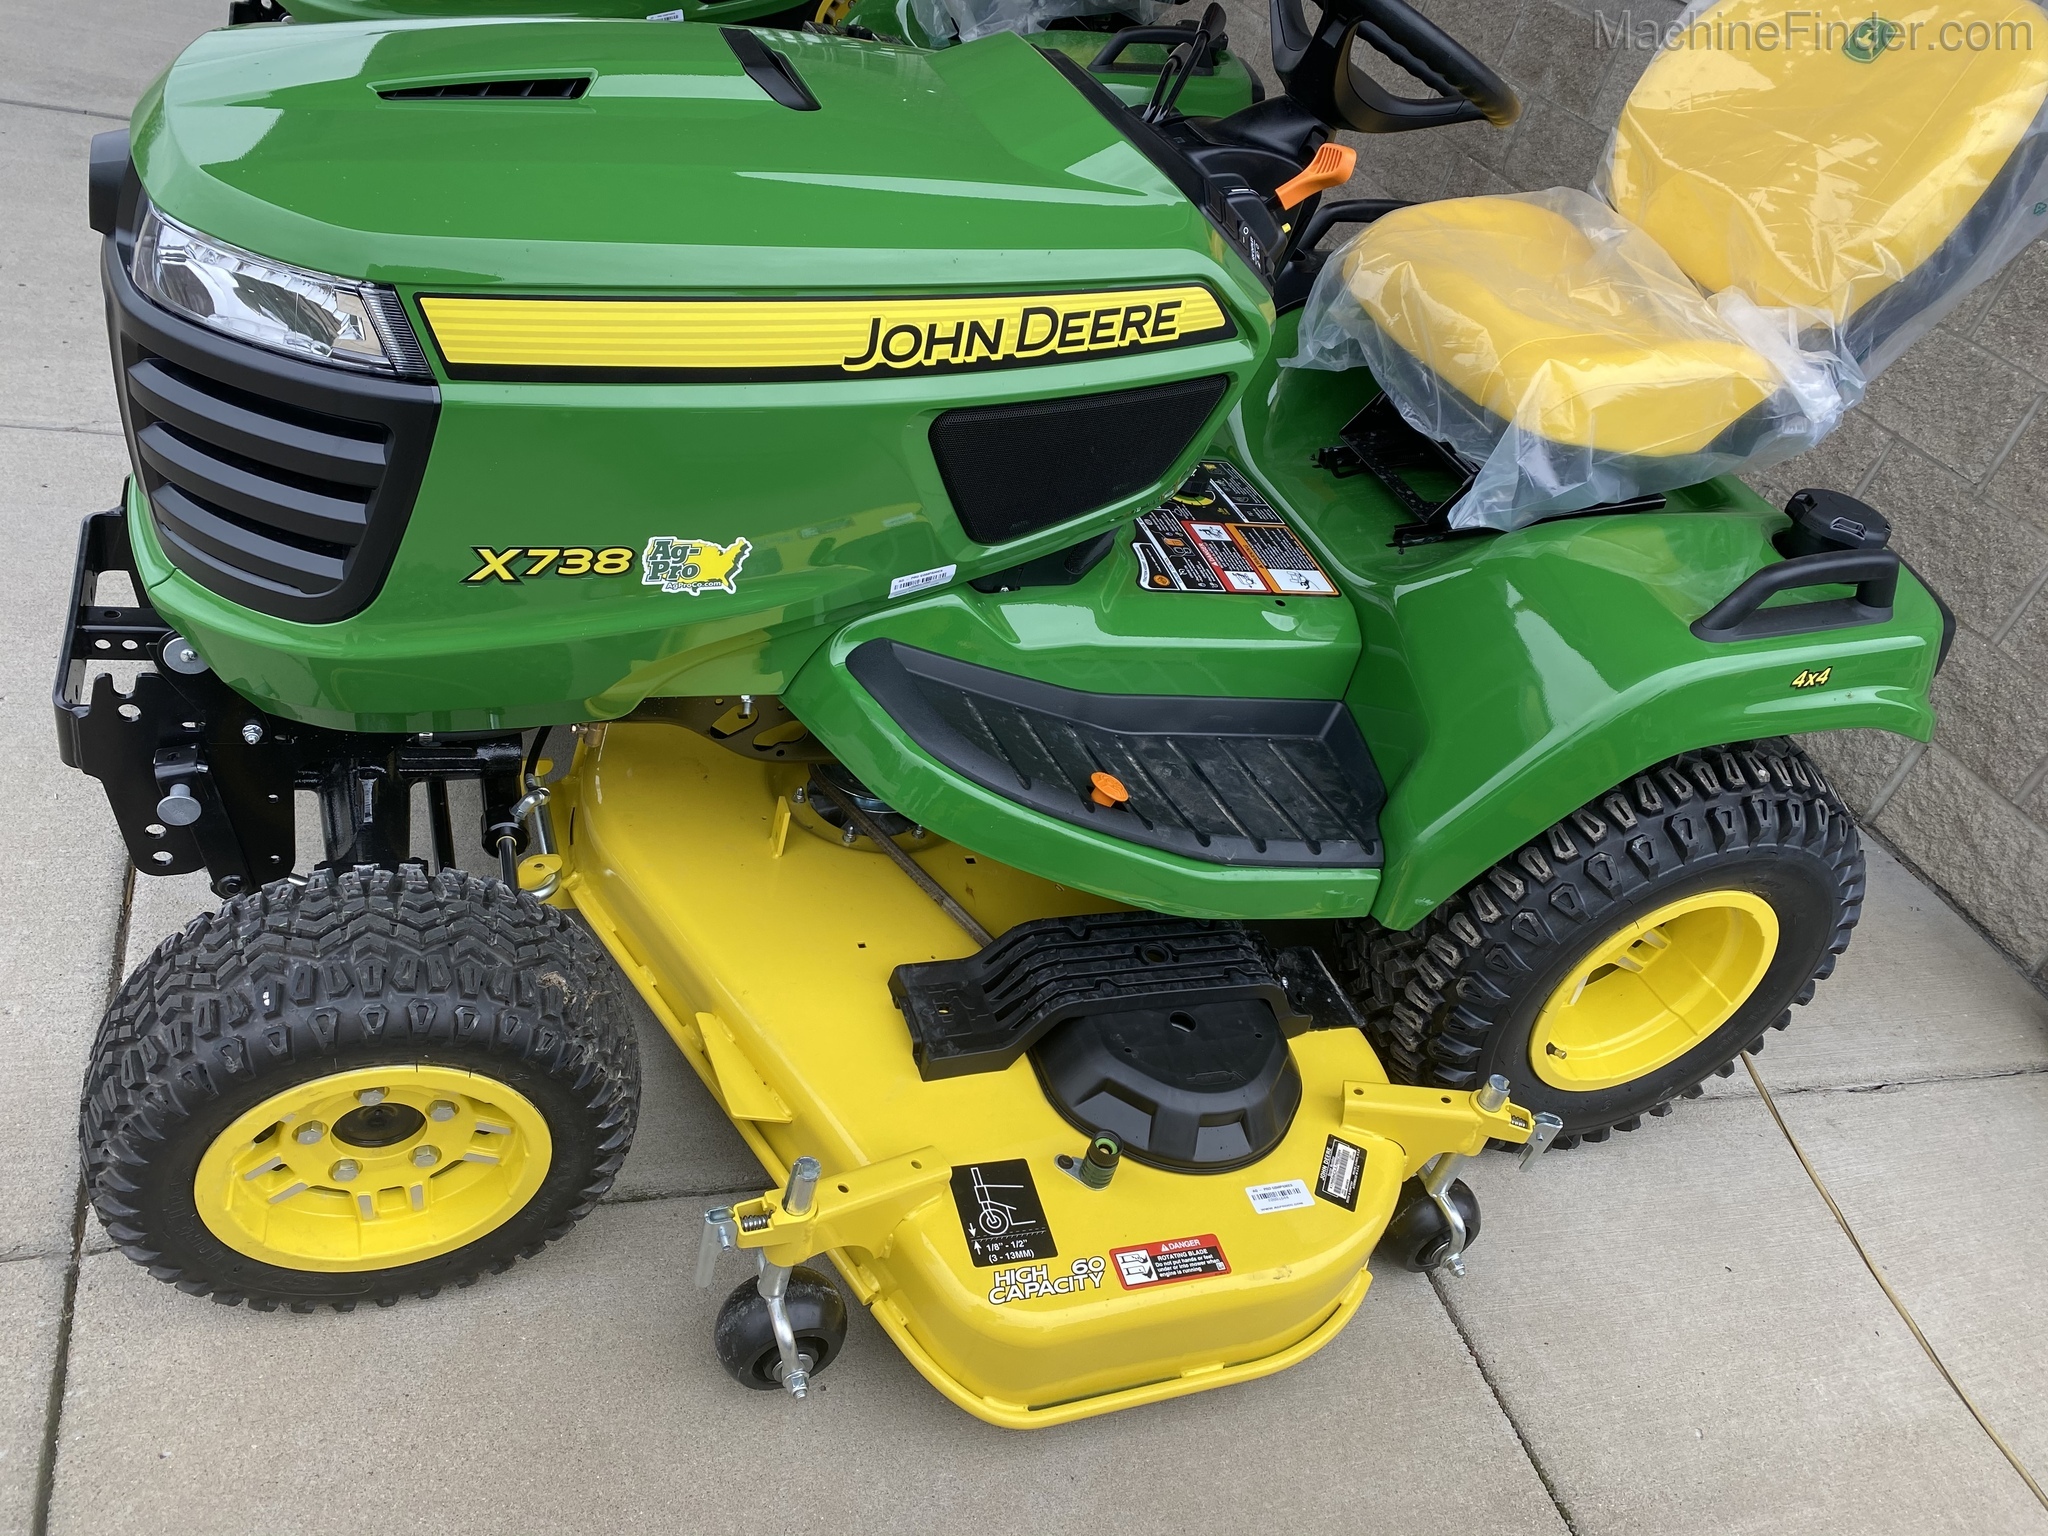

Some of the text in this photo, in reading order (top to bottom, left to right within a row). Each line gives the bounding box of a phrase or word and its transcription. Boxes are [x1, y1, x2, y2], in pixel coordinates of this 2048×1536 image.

[842, 300, 1182, 373] JOHN DEERE
[647, 538, 702, 564] Ag-
[459, 545, 636, 585] X738
[645, 561, 700, 582] Pro
[666, 581, 722, 590] AgProCo.com
[1790, 666, 1833, 689] 4x4
[1323, 1147, 1333, 1164] DEERE
[1320, 1164, 1328, 1181] JOHN
[1169, 1239, 1201, 1250] DANGER
[1006, 1249, 1035, 1259] 13MM)
[1157, 1249, 1208, 1261] ROTATING BLADE
[1182, 1256, 1198, 1264] hands
[994, 1256, 1106, 1287] HIGH 60
[1157, 1265, 1172, 1273] under
[1159, 1270, 1177, 1278] engine
[1182, 1266, 1202, 1274] running
[988, 1270, 1105, 1305] CAPACITY
